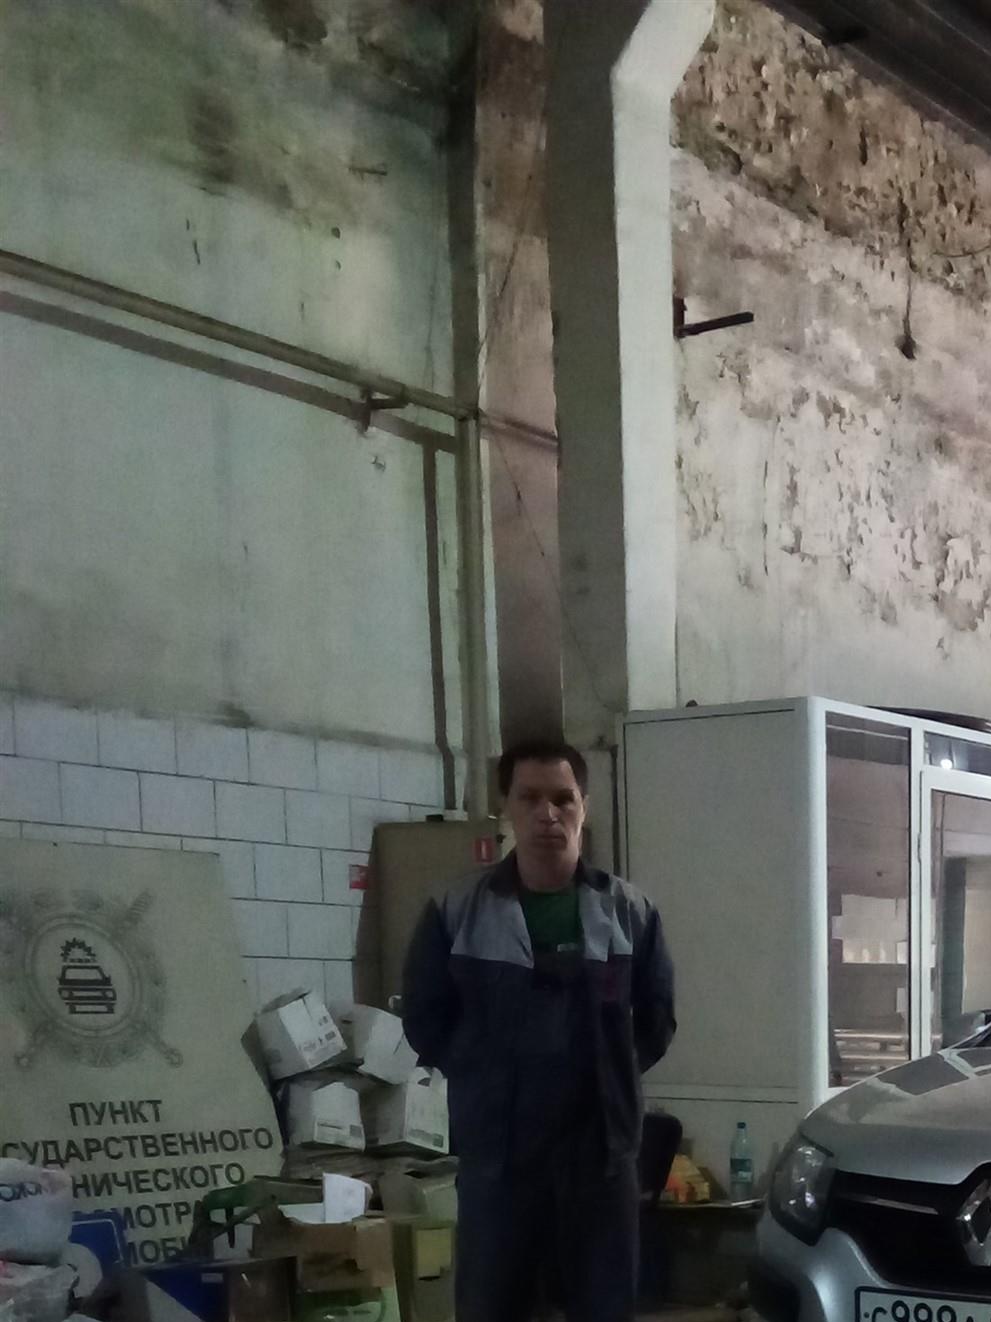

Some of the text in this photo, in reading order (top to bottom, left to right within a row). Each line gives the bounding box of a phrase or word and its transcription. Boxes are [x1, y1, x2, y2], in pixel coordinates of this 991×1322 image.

[69, 1099, 163, 1127] ПУНКТ
[1, 1127, 274, 1168] СУДАРСТВЕННОГО
[72, 1162, 246, 1199] НИЧЕСКОГО
